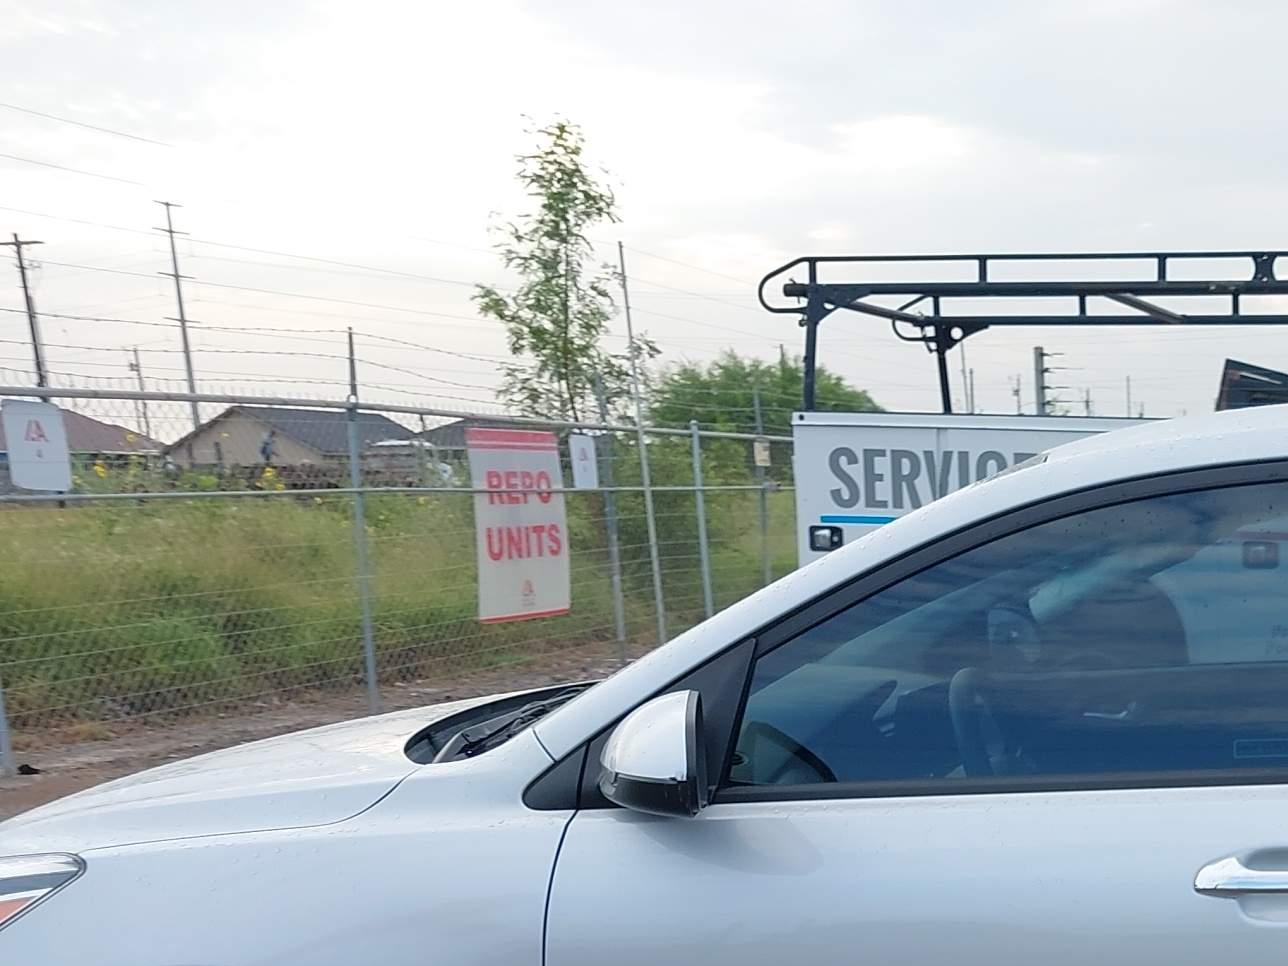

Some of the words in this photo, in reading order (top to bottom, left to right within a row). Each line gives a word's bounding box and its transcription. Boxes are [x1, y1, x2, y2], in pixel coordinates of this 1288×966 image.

[486, 470, 553, 505] REPO
[827, 446, 1038, 510] SERVI
[485, 523, 562, 561] UNITS
